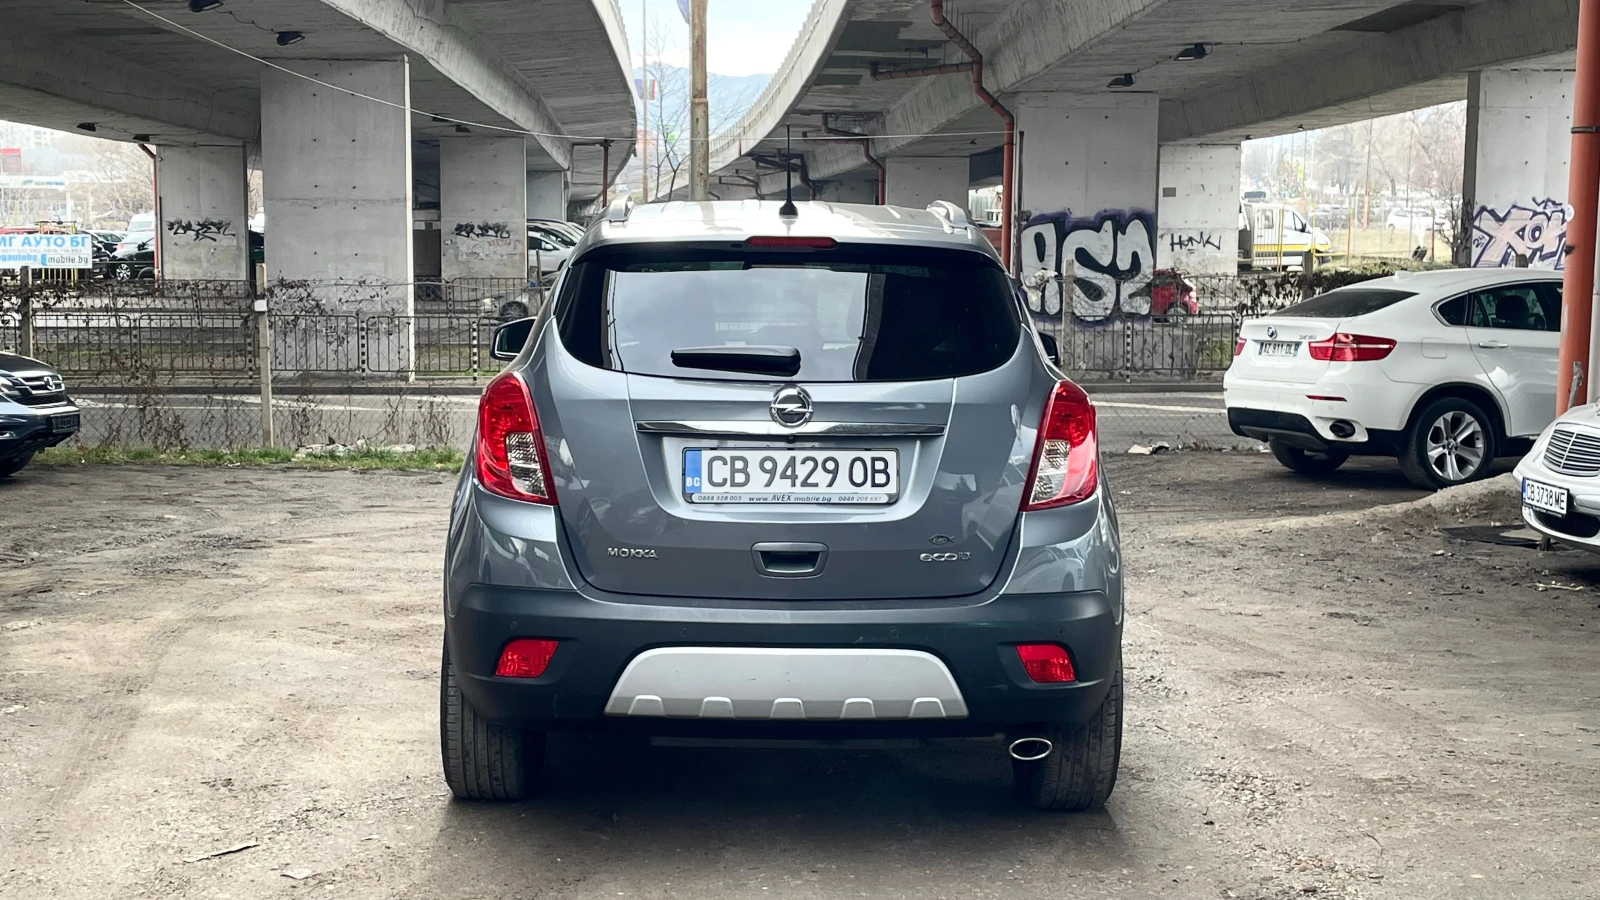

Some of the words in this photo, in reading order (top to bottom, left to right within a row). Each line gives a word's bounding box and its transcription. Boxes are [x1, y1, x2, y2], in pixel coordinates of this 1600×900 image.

[21, 236, 65, 247] АУТО
[70, 236, 89, 247] БГ
[707, 455, 750, 487] CB
[759, 455, 840, 487] 9429
[686, 477, 700, 487] BG
[1527, 483, 1535, 501] CB
[1536, 485, 1554, 506] 3738
[1554, 490, 1565, 510] ME
[607, 547, 659, 559] MOKKA
